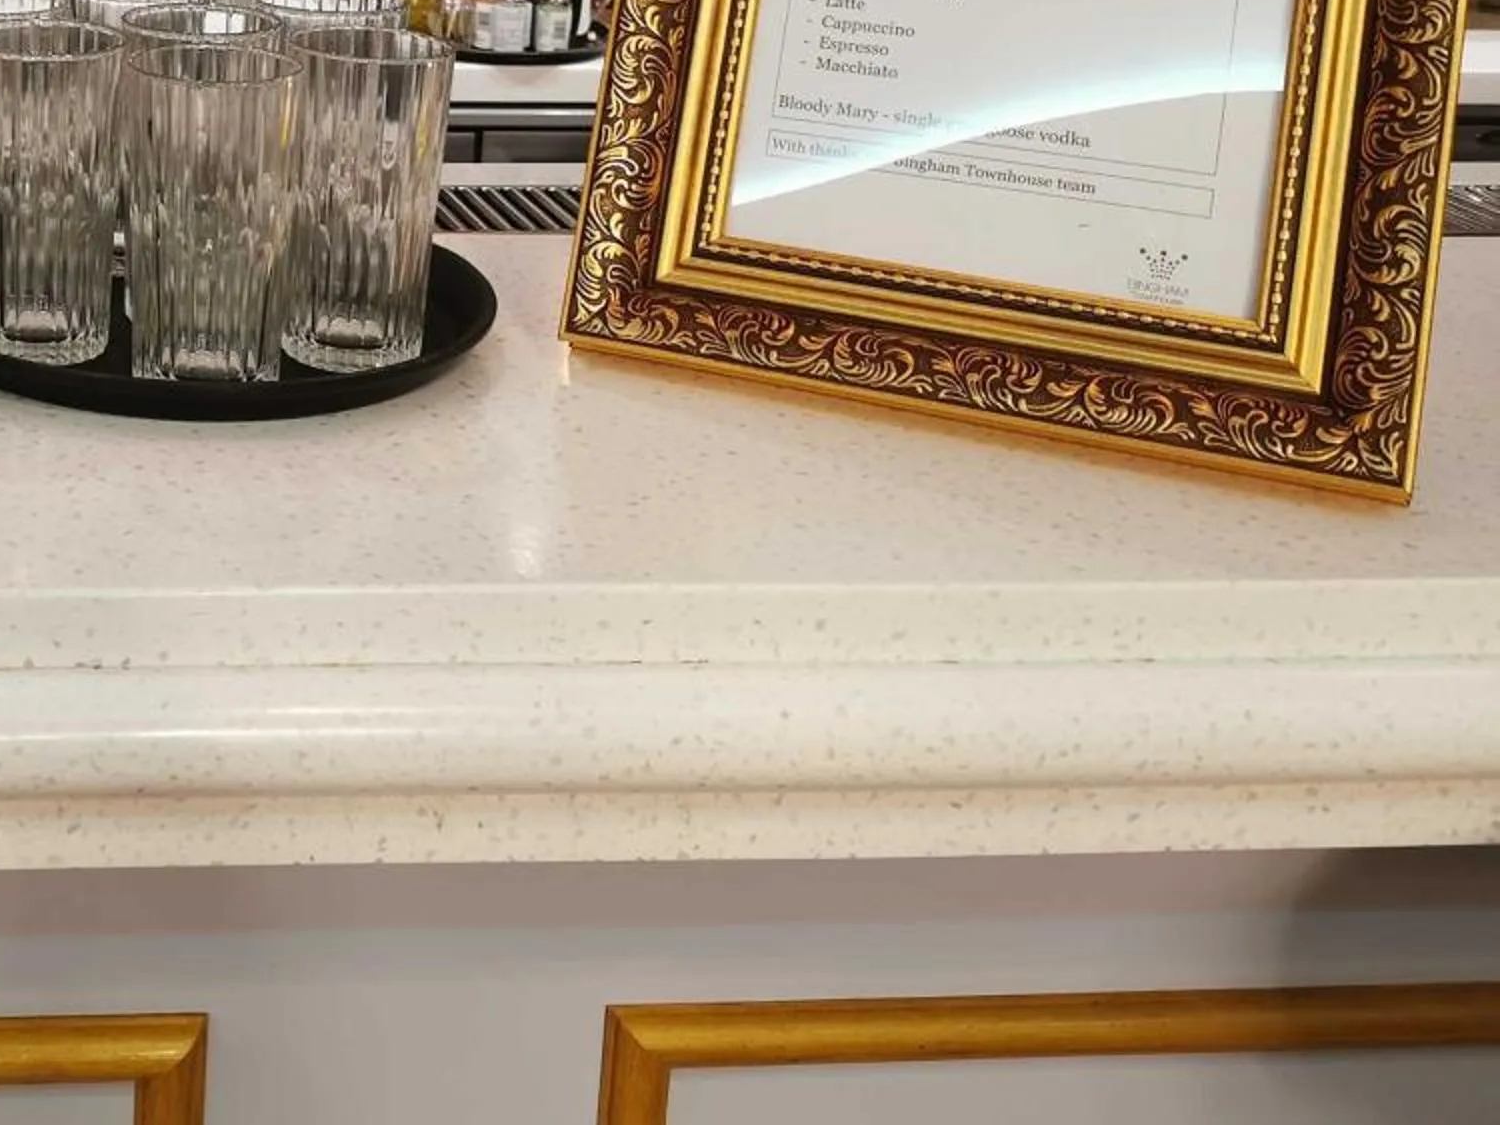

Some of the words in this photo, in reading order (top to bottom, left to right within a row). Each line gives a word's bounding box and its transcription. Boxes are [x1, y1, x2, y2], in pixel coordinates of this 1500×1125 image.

[821, 15, 916, 38] Cappuccino
[819, 35, 890, 56] Espresso
[815, 55, 899, 79] Macchiato
[778, 94, 832, 116] Bloody
[836, 101, 880, 123] Mary
[1038, 129, 1093, 149] vodka
[772, 137, 806, 154] With
[964, 162, 1054, 188] Townhouse
[1056, 177, 1097, 195] team
